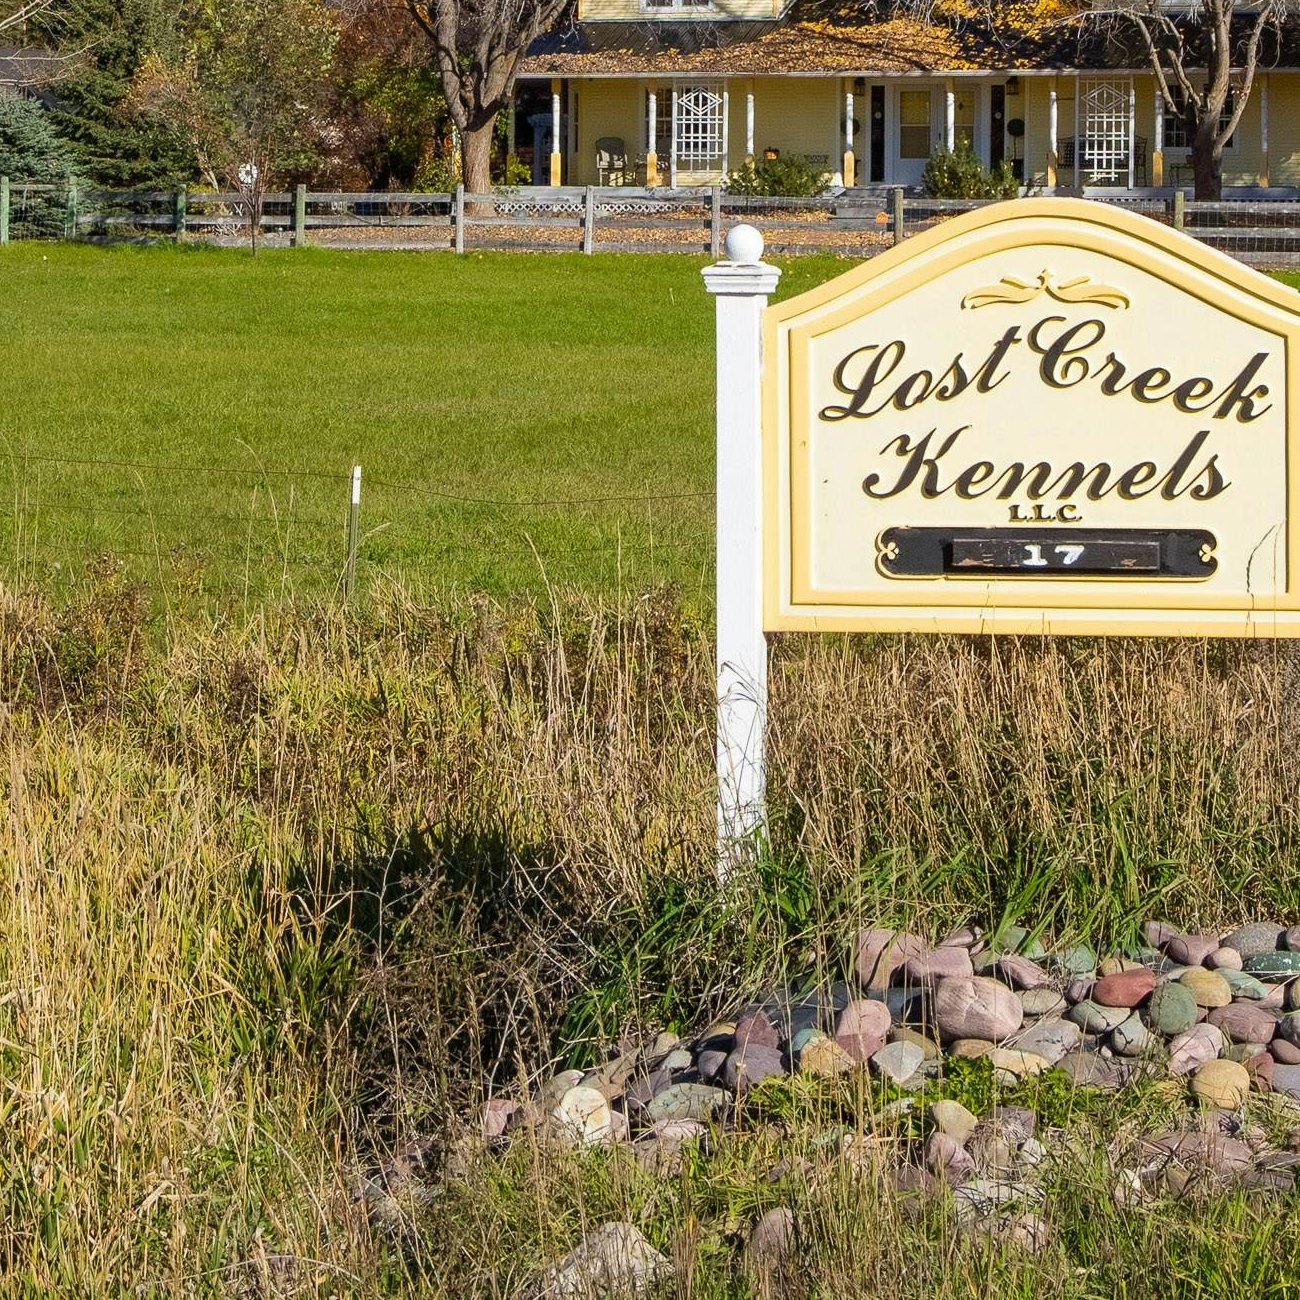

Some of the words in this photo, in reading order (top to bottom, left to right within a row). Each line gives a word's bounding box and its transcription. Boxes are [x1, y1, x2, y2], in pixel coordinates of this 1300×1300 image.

[818, 325, 1022, 422] Lost
[1027, 315, 1273, 424] Creek
[861, 425, 1232, 502] Kennels
[1022, 544, 1085, 566] 17
